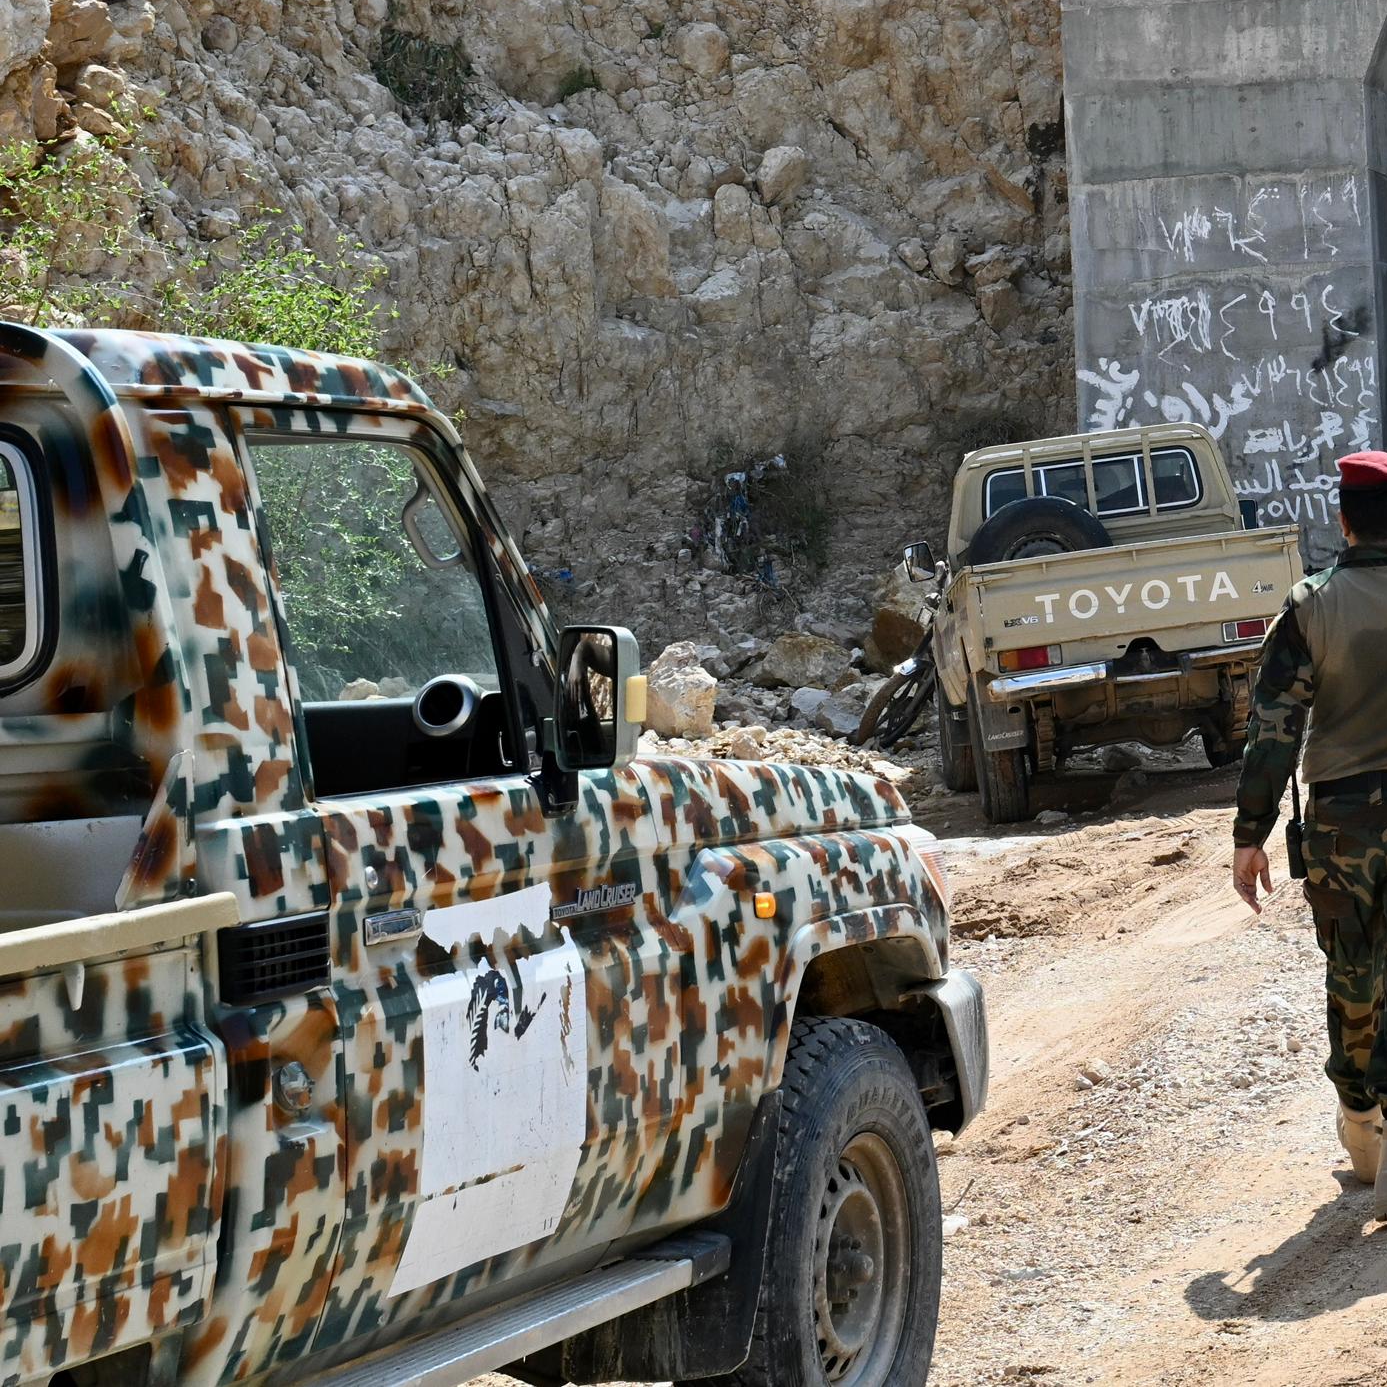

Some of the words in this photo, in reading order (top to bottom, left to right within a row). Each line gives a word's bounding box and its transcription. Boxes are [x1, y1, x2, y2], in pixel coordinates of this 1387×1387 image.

[1035, 571, 1239, 623] TOYOTA
[577, 887, 600, 911] LAND
[601, 883, 636, 908] CRUISER
